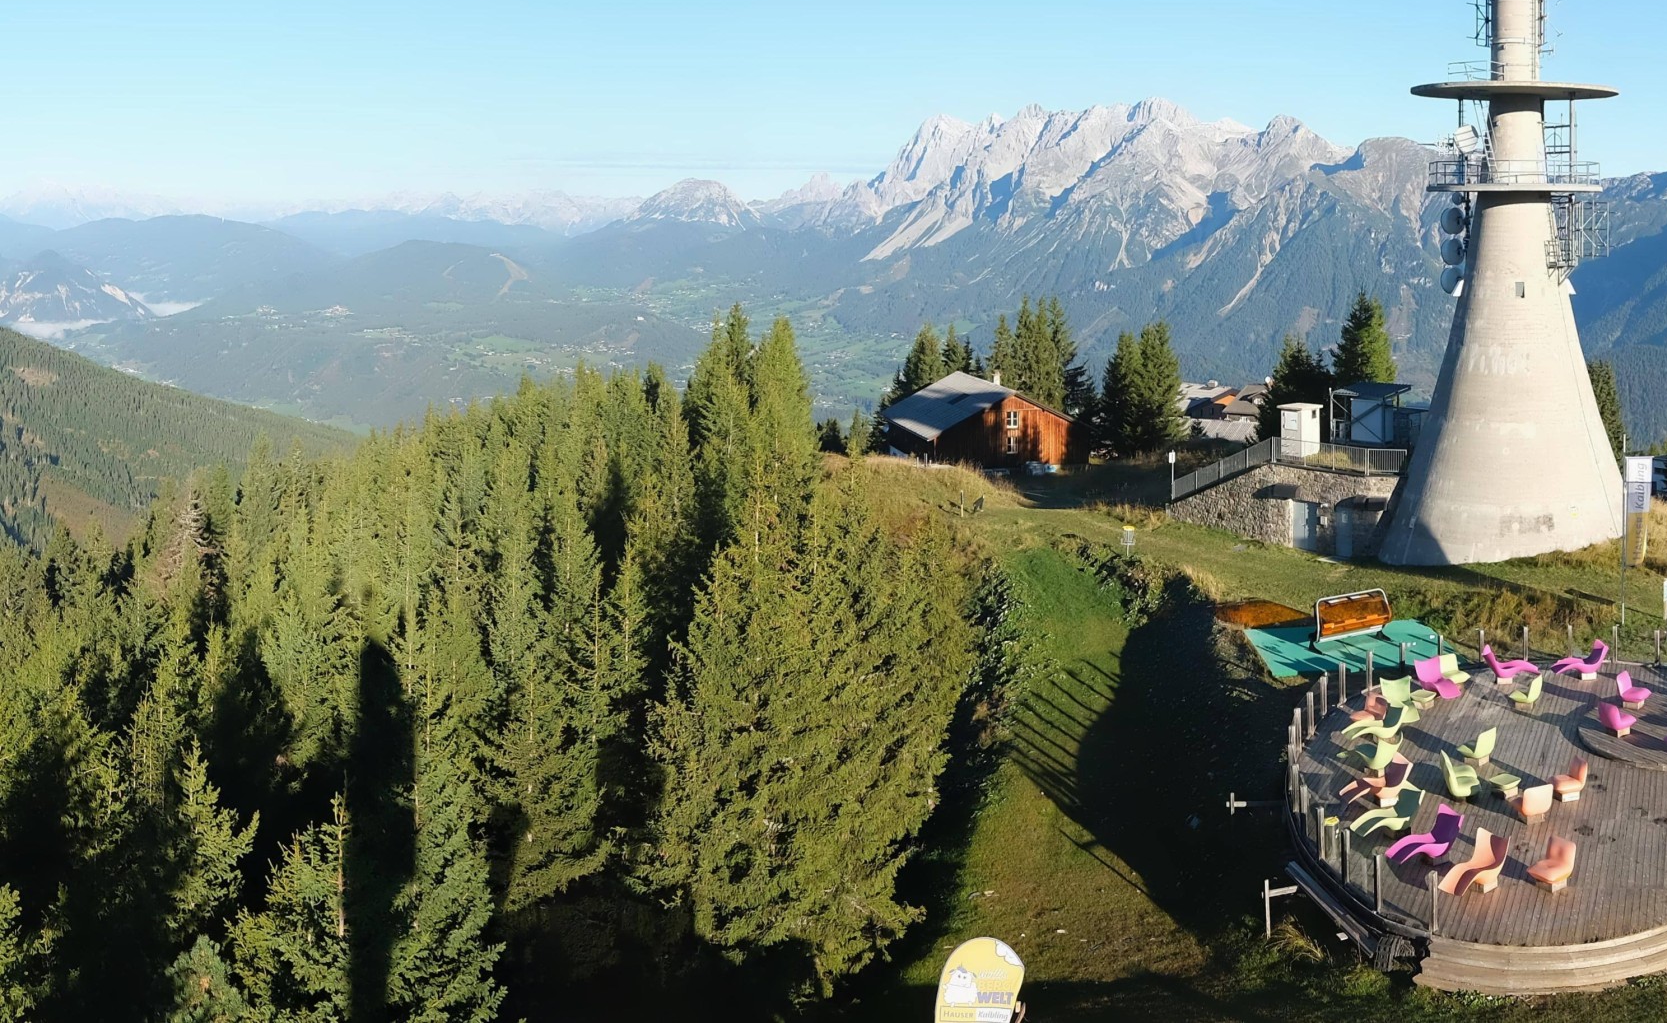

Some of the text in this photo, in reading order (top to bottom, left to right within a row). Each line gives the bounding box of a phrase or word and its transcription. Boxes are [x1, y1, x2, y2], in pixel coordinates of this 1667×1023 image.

[1635, 462, 1648, 509] Kaibling
[976, 991, 1014, 1005] WELT
[943, 1008, 1009, 1022] HAUSER Kaibling
